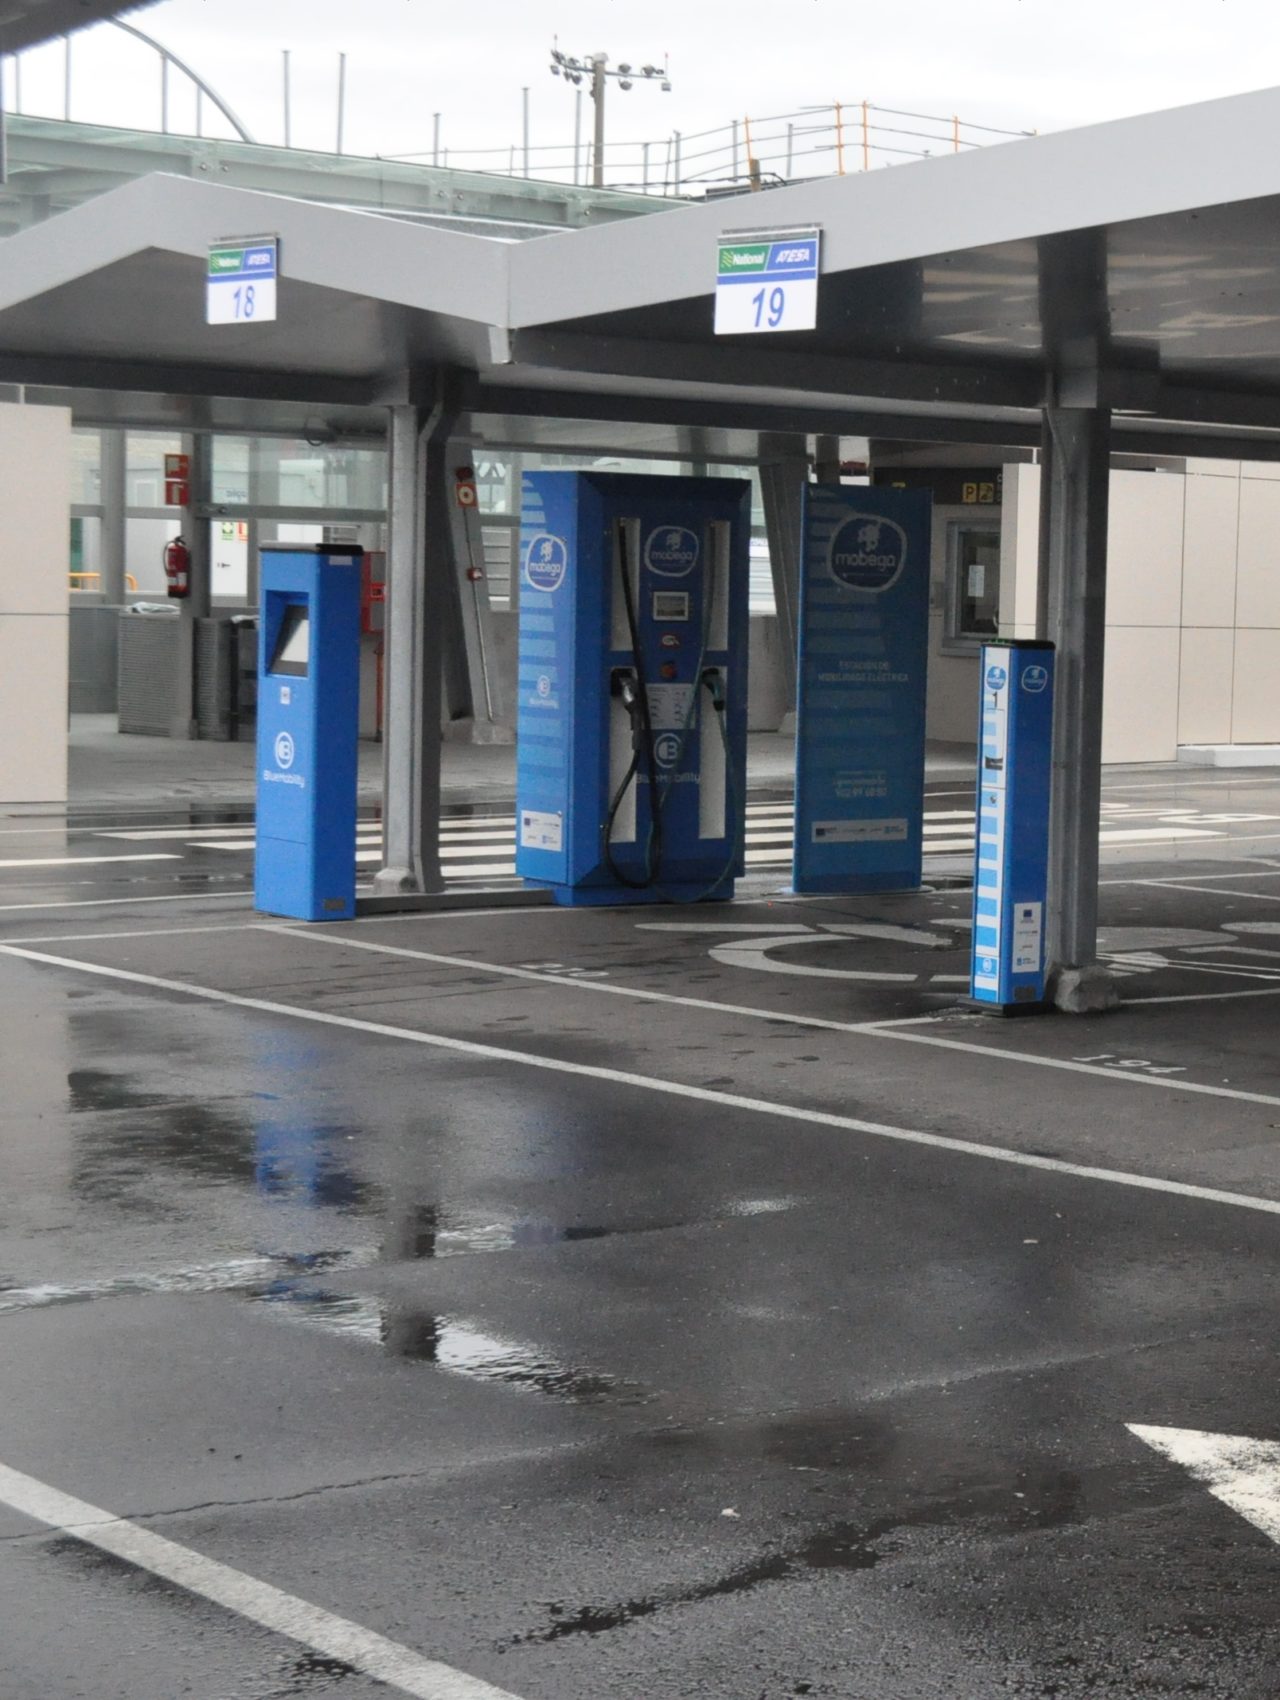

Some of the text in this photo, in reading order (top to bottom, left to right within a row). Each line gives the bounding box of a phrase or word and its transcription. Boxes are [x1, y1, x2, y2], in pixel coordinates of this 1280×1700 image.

[732, 252, 765, 265] National
[233, 285, 255, 318] 18
[752, 287, 784, 327] 19
[965, 485, 974, 498] P
[650, 548, 693, 563] mobega
[835, 551, 896, 572] mobega
[529, 560, 561, 576] mobega
[992, 691, 998, 708] 1
